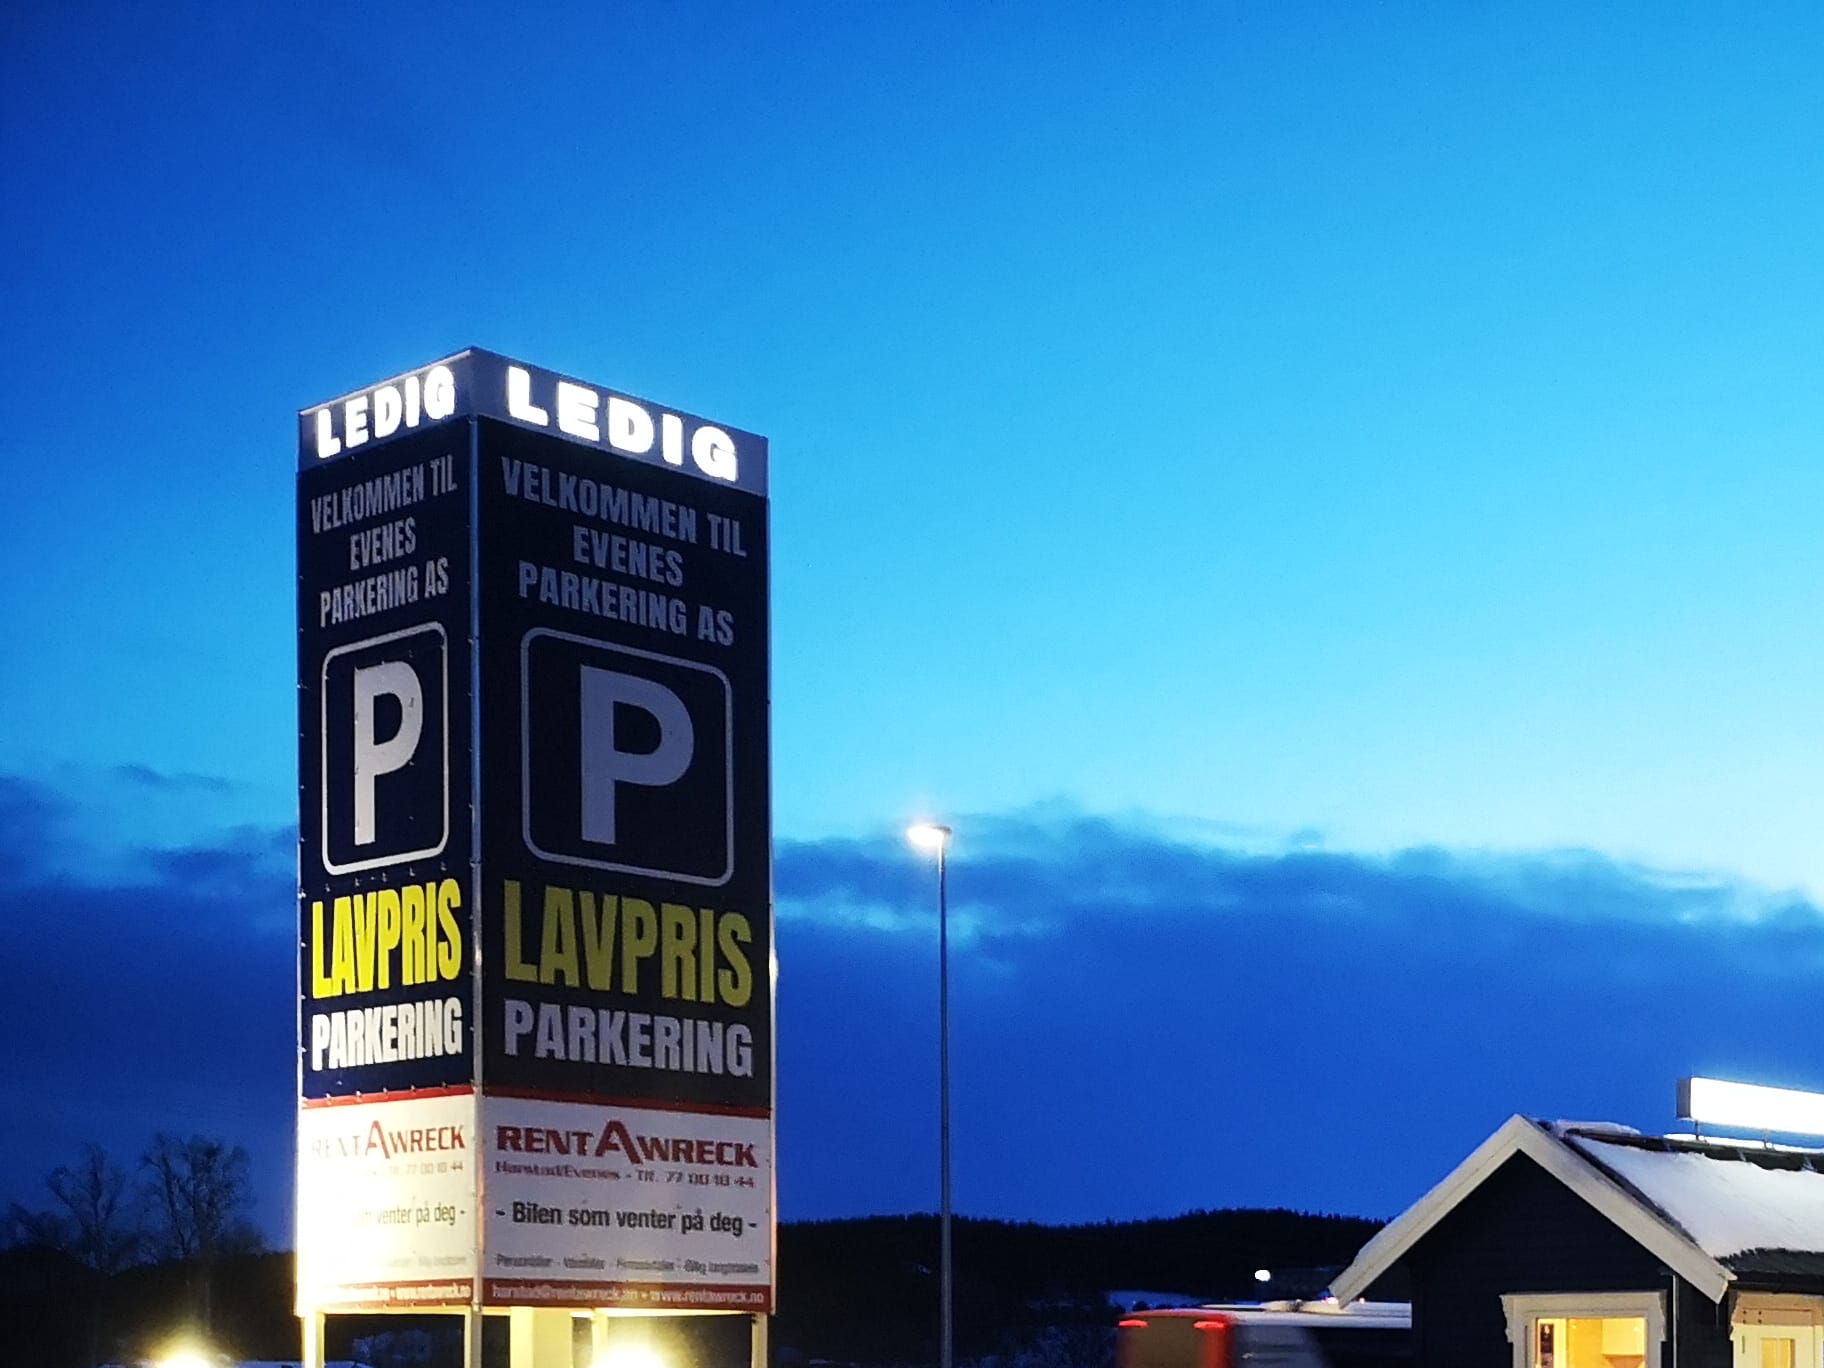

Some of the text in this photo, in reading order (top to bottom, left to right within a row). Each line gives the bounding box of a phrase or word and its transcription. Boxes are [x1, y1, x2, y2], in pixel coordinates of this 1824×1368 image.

[317, 364, 455, 459] LEDIG
[507, 366, 738, 482] LEDIG
[311, 454, 457, 534] VELKOMMEN TIL
[501, 456, 747, 557] VELKOMMEN TIL
[350, 516, 416, 571] EVENES
[573, 525, 684, 588] EVENES
[320, 556, 450, 629] PARKERING AS
[518, 560, 734, 647] PARKERING AS
[354, 660, 423, 846] P
[580, 663, 695, 845] P
[312, 878, 462, 999] LAVPRIS
[504, 879, 753, 1009] LAVPRIS
[312, 997, 463, 1072] PARKERING
[504, 998, 754, 1079] PARKERING
[434, 1202, 456, 1226] deg
[512, 1200, 562, 1226] Bilen
[568, 1209, 610, 1227] som
[616, 1209, 676, 1230] venter
[682, 1210, 704, 1235] på
[710, 1211, 743, 1237] deg
